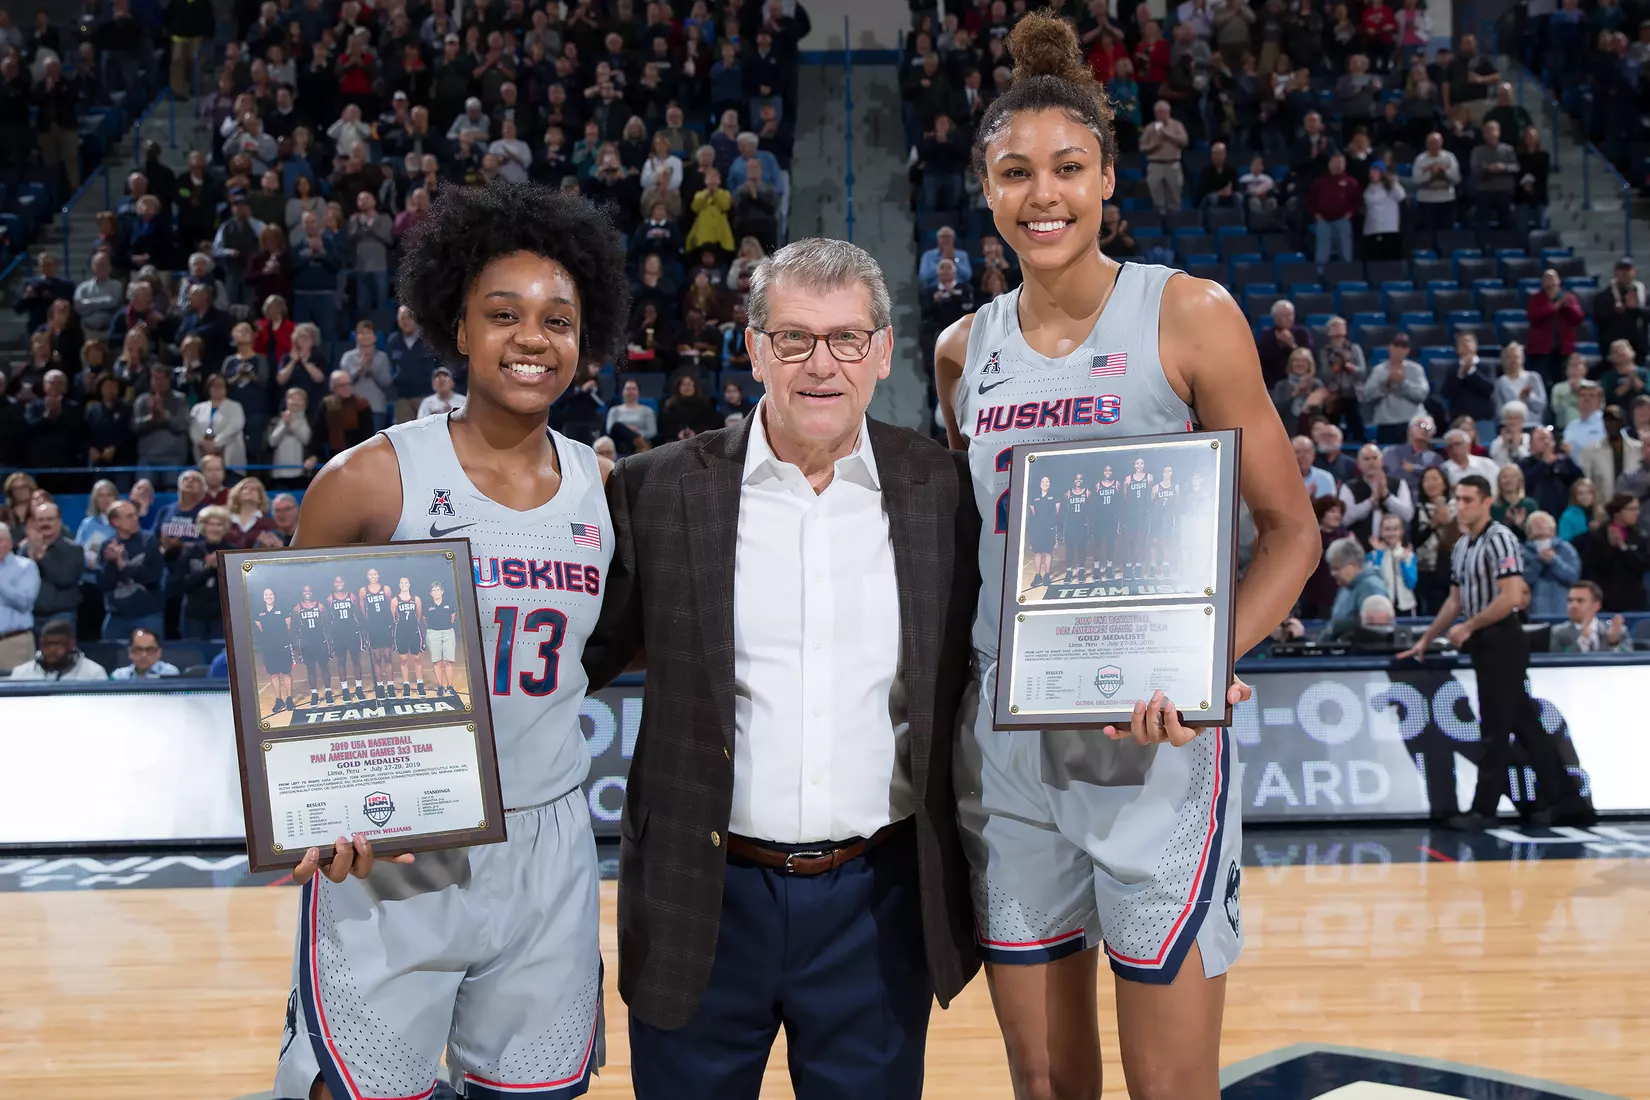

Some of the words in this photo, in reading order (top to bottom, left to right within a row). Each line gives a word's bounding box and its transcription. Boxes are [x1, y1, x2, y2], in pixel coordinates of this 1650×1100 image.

[975, 394, 1121, 436] HUSKIES
[1104, 496, 1111, 504] 10
[472, 558, 600, 596] USKIES
[1058, 586, 1130, 598] TEAM
[367, 594, 384, 603] USA
[334, 602, 351, 610] USA
[375, 603, 380, 612] 9
[399, 603, 415, 611] USA
[301, 611, 319, 619] USA
[340, 610, 348, 619] 10
[405, 611, 410, 620] 7
[308, 619, 315, 628] 11
[493, 606, 568, 697] 13
[306, 706, 386, 724] TEAM
[394, 702, 456, 714] USA
[330, 742, 348, 752] 2019
[351, 740, 366, 750] USA
[368, 736, 412, 748] BASKETBALL
[310, 754, 326, 764] PAN
[328, 750, 368, 762] AMERICAN
[370, 747, 395, 757] GAMES
[397, 746, 411, 755] 3x3
[413, 744, 433, 753] TEAM
[364, 756, 410, 766] MEDALISTS
